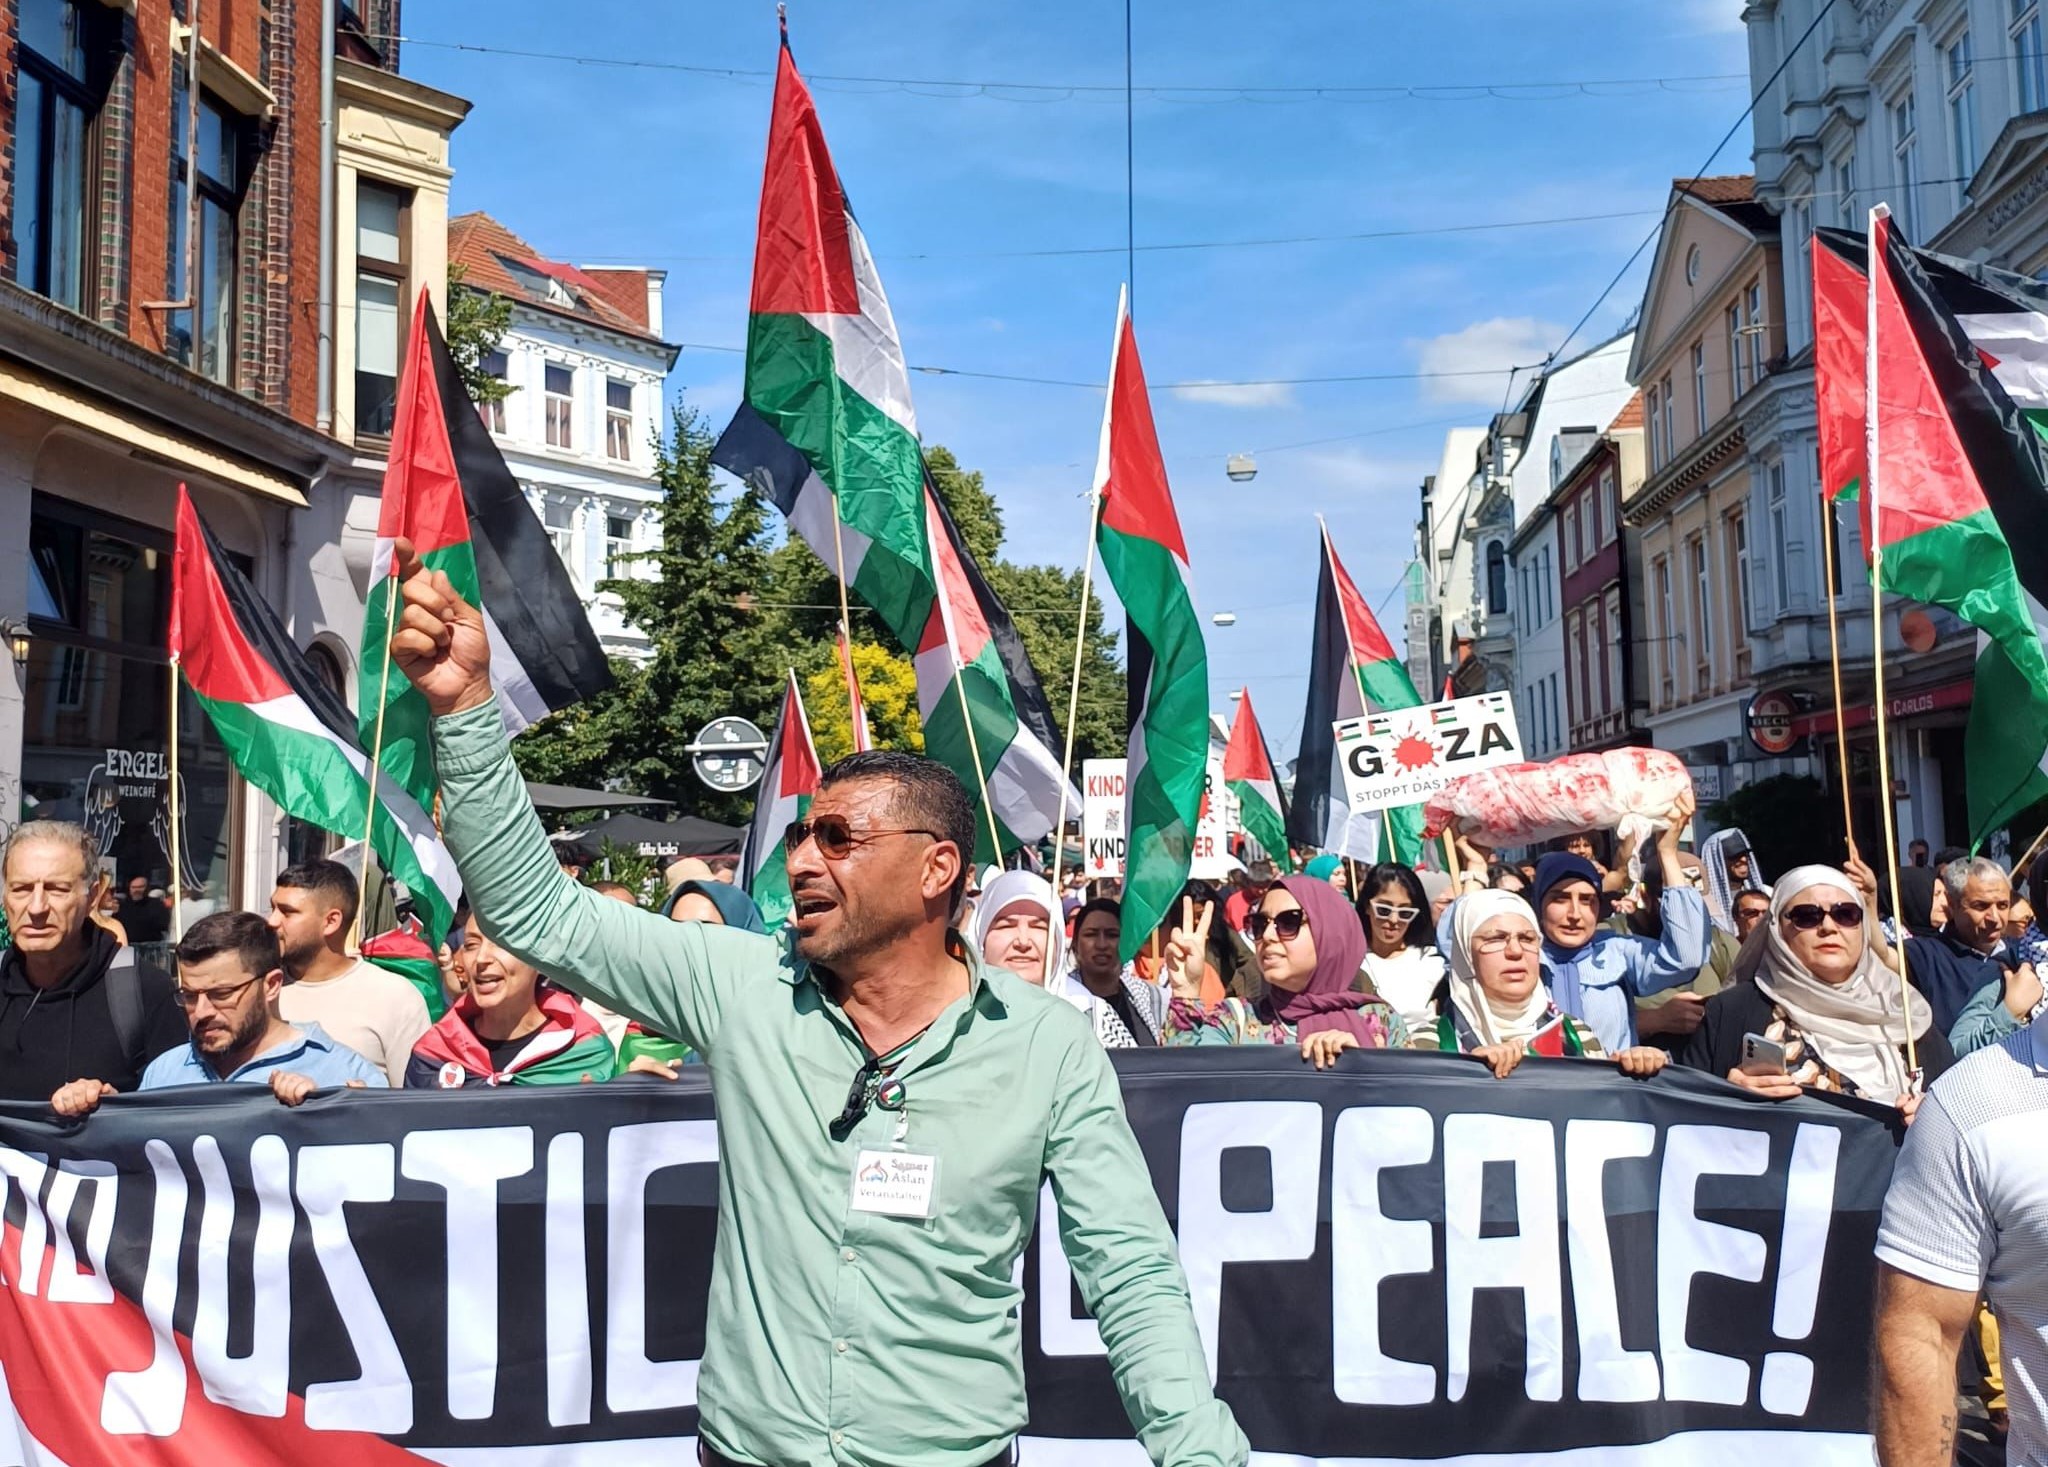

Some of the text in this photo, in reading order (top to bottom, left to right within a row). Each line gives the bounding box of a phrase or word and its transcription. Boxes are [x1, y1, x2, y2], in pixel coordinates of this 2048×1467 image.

[1348, 722, 1515, 779] GZA
[105, 749, 169, 780] ENGEL
[118, 782, 156, 798] WEINCAFÉ
[1356, 784, 1409, 803] STOPPT
[1412, 779, 1441, 794] DAS
[891, 1172, 926, 1185] Aslan
[859, 1188, 923, 1201] Veranstalter
[100, 1119, 719, 1437] JUSTIC
[1177, 1100, 1842, 1417] PEACE!
